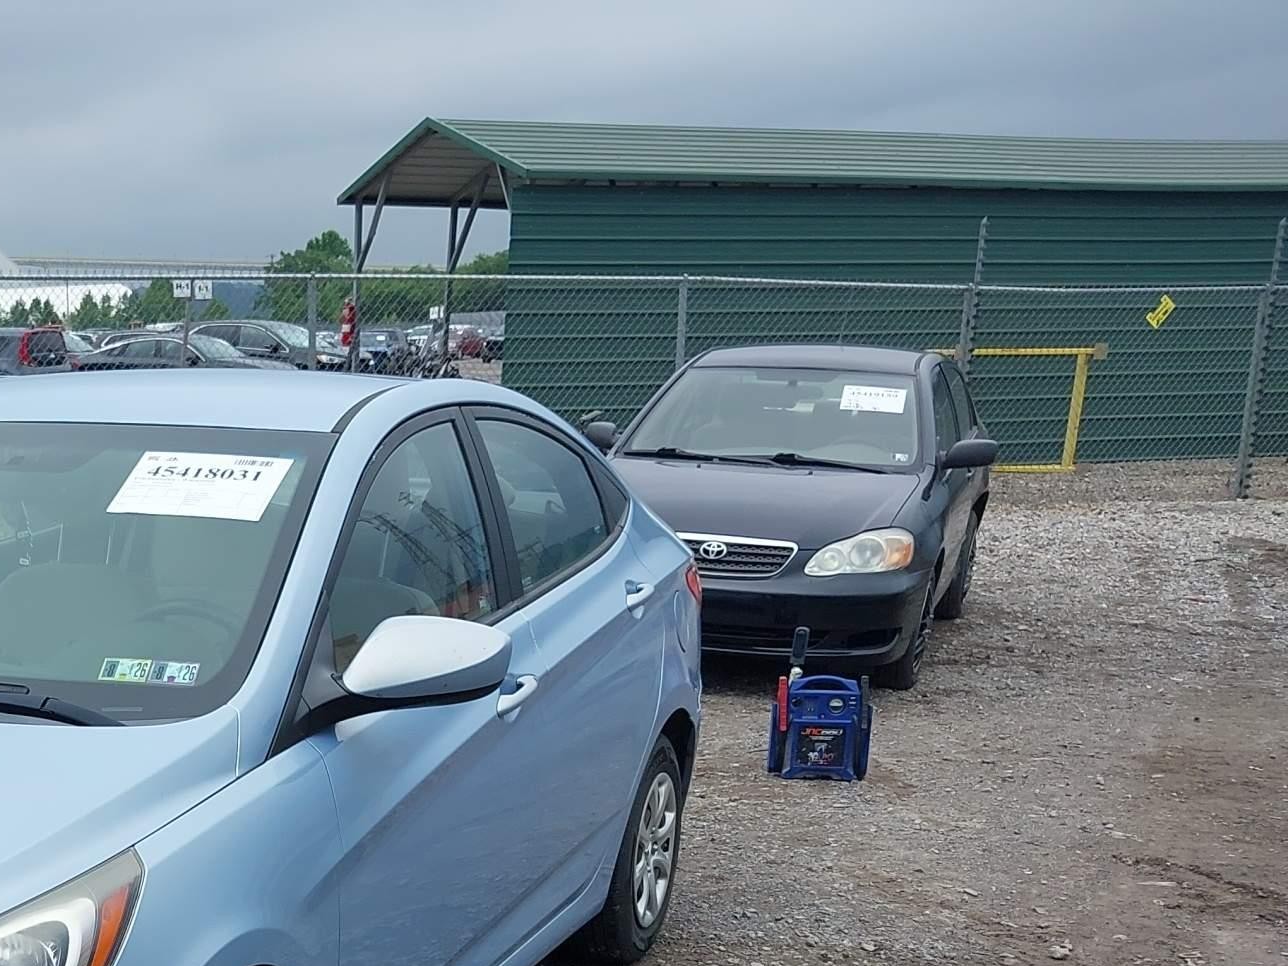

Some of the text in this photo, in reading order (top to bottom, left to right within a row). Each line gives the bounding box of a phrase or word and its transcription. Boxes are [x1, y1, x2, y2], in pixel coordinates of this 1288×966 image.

[146, 465, 263, 482] 45418031
[133, 662, 149, 678] 26
[182, 665, 197, 681] 26
